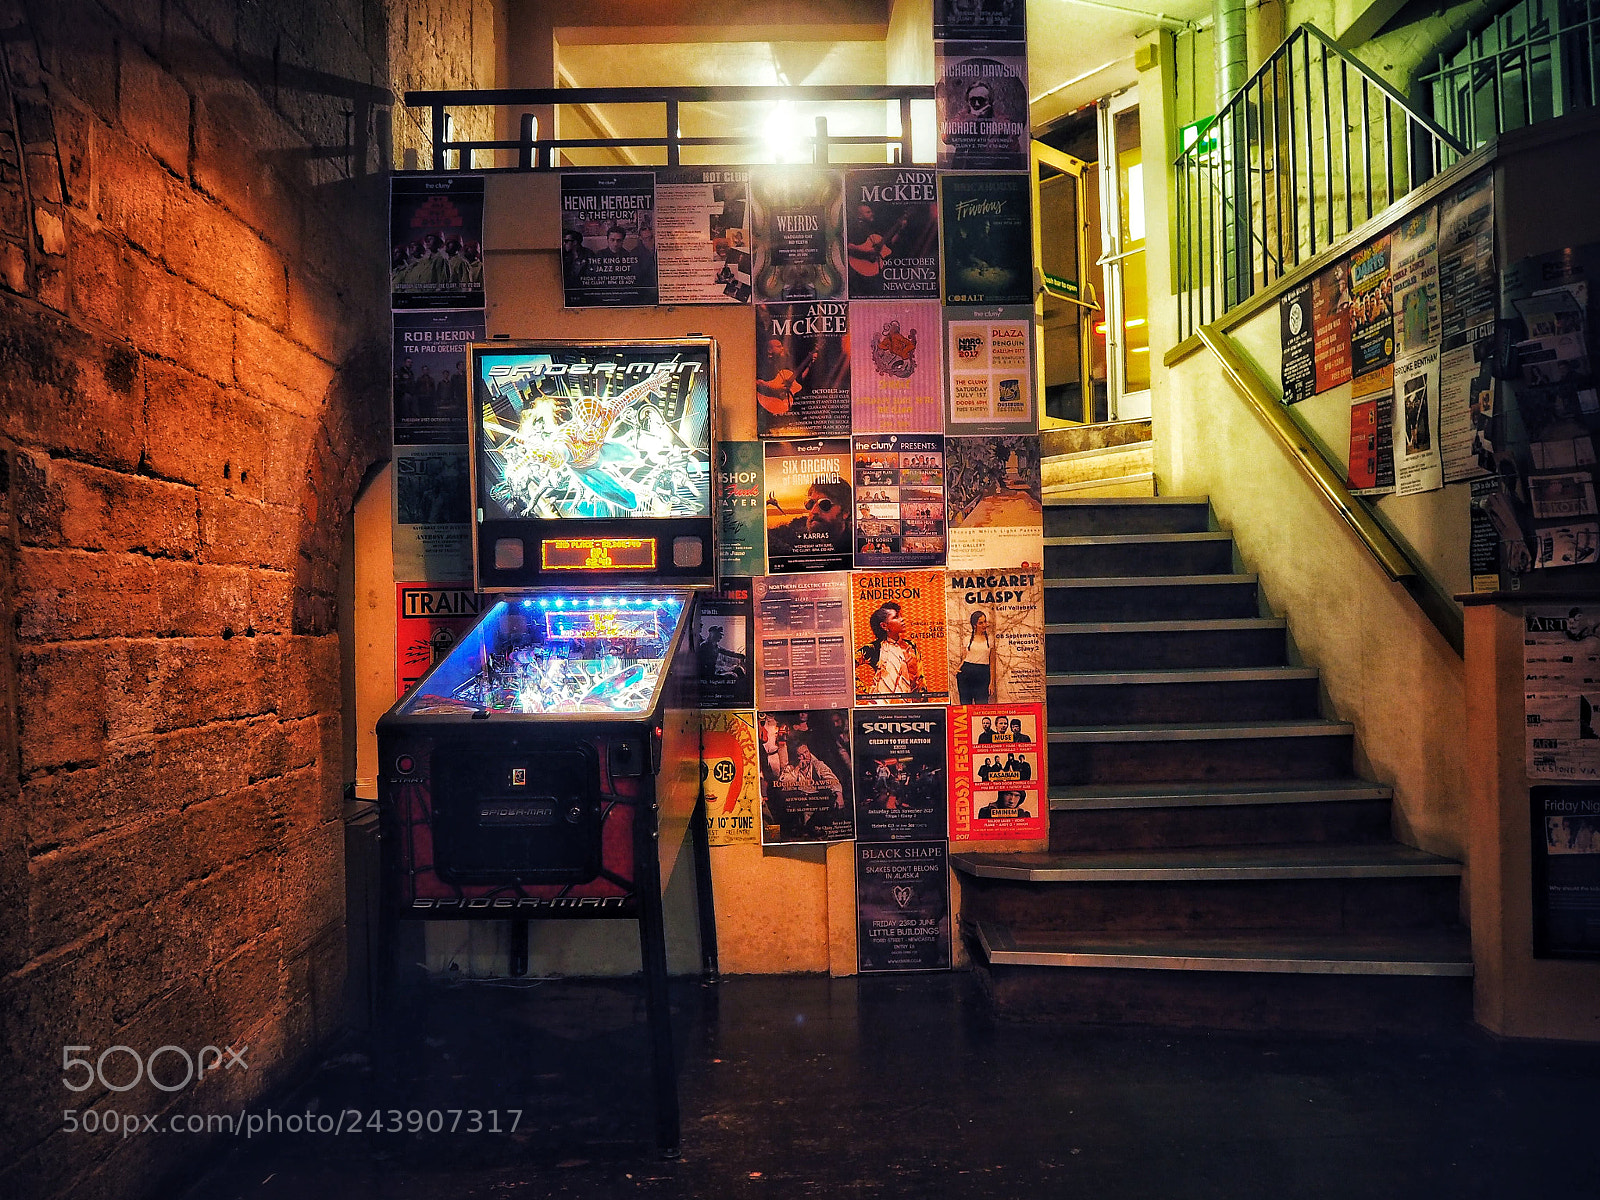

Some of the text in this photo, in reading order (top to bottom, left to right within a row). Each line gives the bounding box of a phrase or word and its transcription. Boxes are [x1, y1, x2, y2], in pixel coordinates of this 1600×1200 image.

[982, 65, 1022, 77] DAWSON
[941, 122, 1023, 134] MICHAEL CHAPMAN
[702, 172, 748, 182] HOT CLUB
[896, 173, 934, 184] ANDY
[564, 195, 651, 210] HENRI HERBERT
[580, 210, 635, 220] & THE FURY
[777, 215, 818, 232] WEIRDS
[894, 257, 935, 265] OCTOBER
[883, 282, 936, 290] NEWCASTLE
[1067, 284, 1078, 292] open
[948, 294, 984, 302] COBALT
[807, 304, 847, 316] ANDY
[404, 331, 475, 341] ROB HERON
[1466, 328, 1478, 343] HOT
[404, 345, 418, 353] TEA
[421, 345, 436, 353] PAD
[1414, 353, 1438, 370] BENTHAM
[488, 362, 703, 376] SPIDER-MAN
[856, 442, 870, 450] the
[871, 441, 895, 451] cluny
[782, 458, 840, 474] SIX ORGANS
[718, 473, 757, 483] SHOP
[793, 473, 841, 485] ADMITTANCE
[803, 532, 829, 540] KARRAS
[860, 577, 906, 588] CARLEEN
[952, 575, 1035, 589] MARGARET
[860, 588, 920, 600] ANDERSON
[965, 591, 1023, 604] GLASPY
[408, 592, 478, 613] TRAIN
[1530, 617, 1568, 631] ART
[862, 722, 937, 733] senser
[953, 706, 970, 831] LEEDS FESTIVAL
[1545, 799, 1579, 813] Friday
[481, 808, 553, 816] SPIDER-MAN
[731, 817, 753, 828] JUNE
[862, 848, 942, 859] BLACK SHAPE
[866, 866, 890, 874] SNAKES
[412, 897, 626, 909] SPIDER-MAN
[869, 927, 939, 937] LITTLE BUILDINGS
